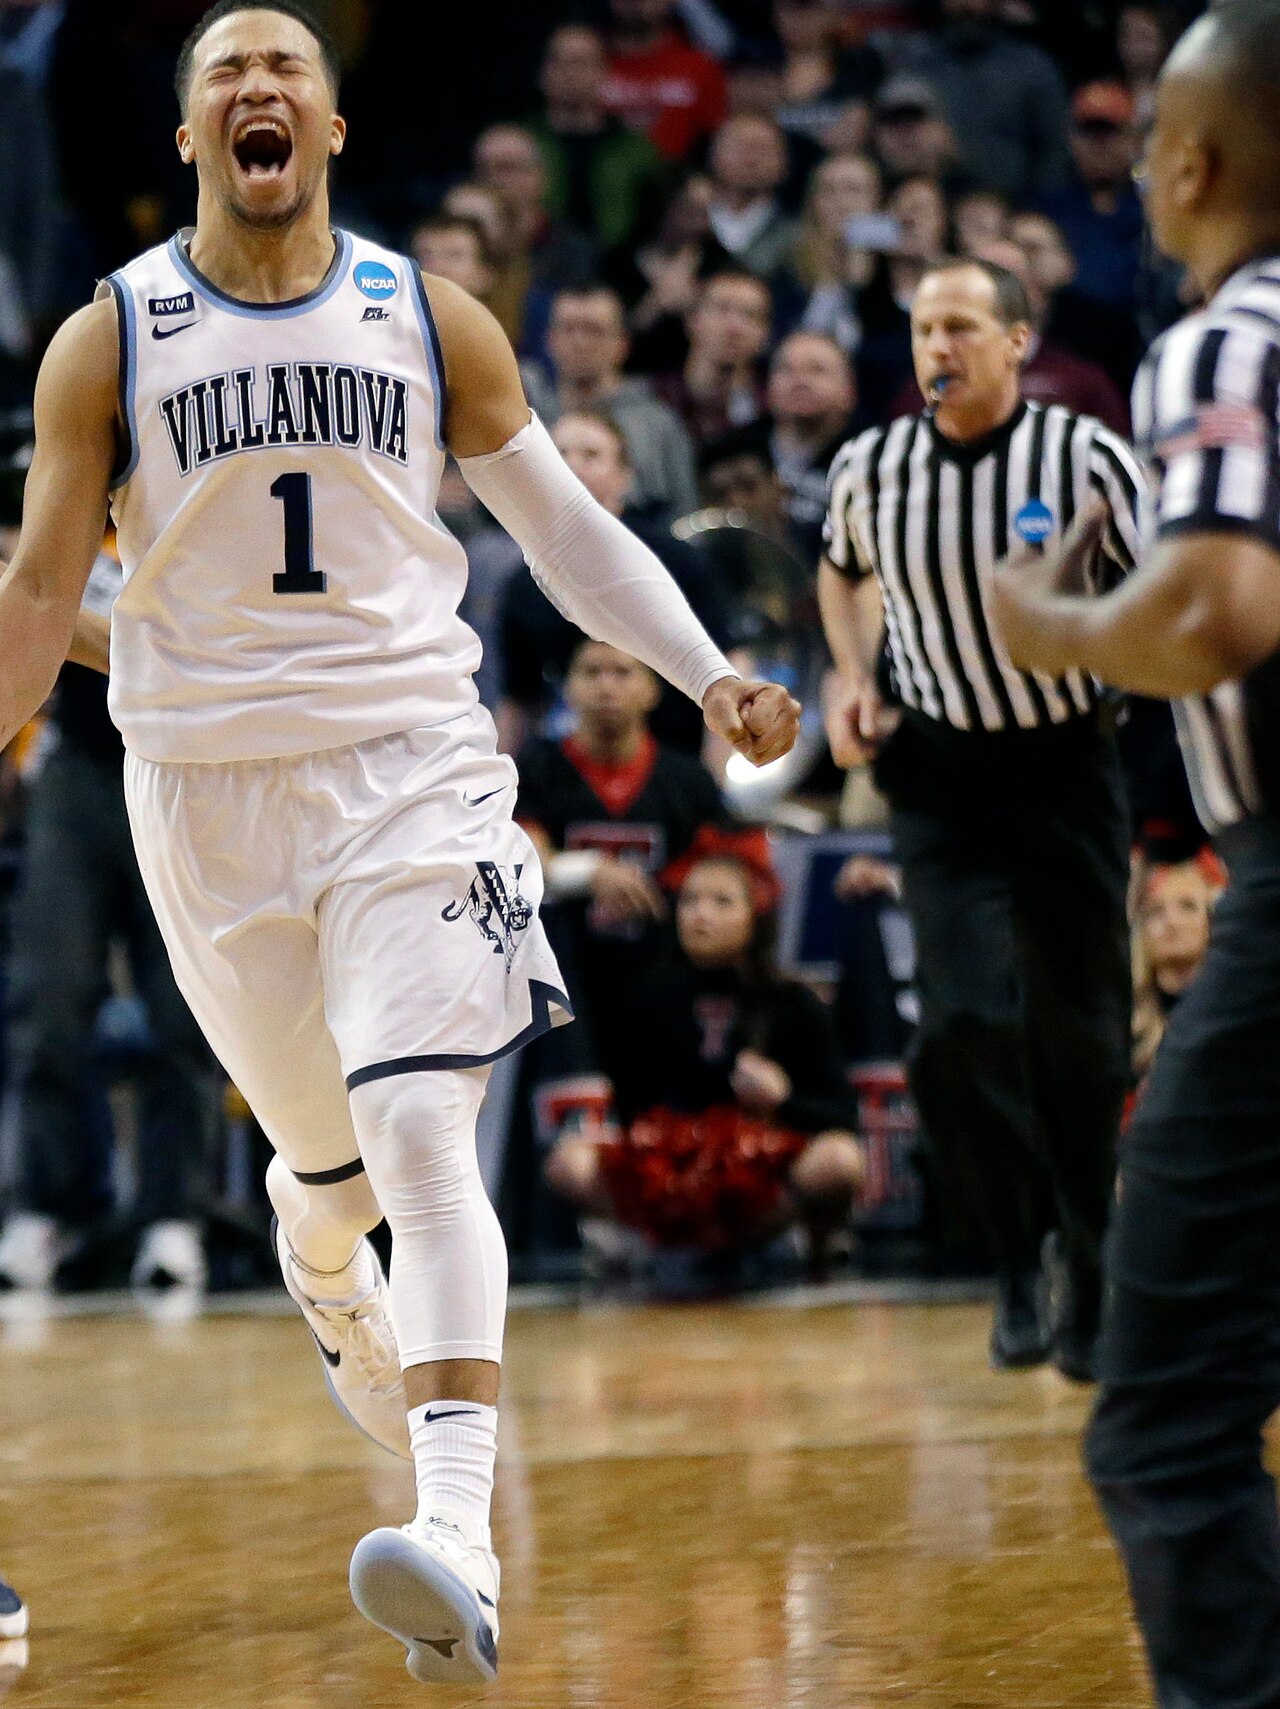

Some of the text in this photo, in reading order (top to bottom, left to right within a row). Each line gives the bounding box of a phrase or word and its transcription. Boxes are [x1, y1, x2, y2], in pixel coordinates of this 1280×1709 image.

[155, 296, 188, 312] RVM
[361, 277, 396, 290] NCAA
[159, 362, 409, 477] VILLANOVA
[270, 472, 327, 593] 1
